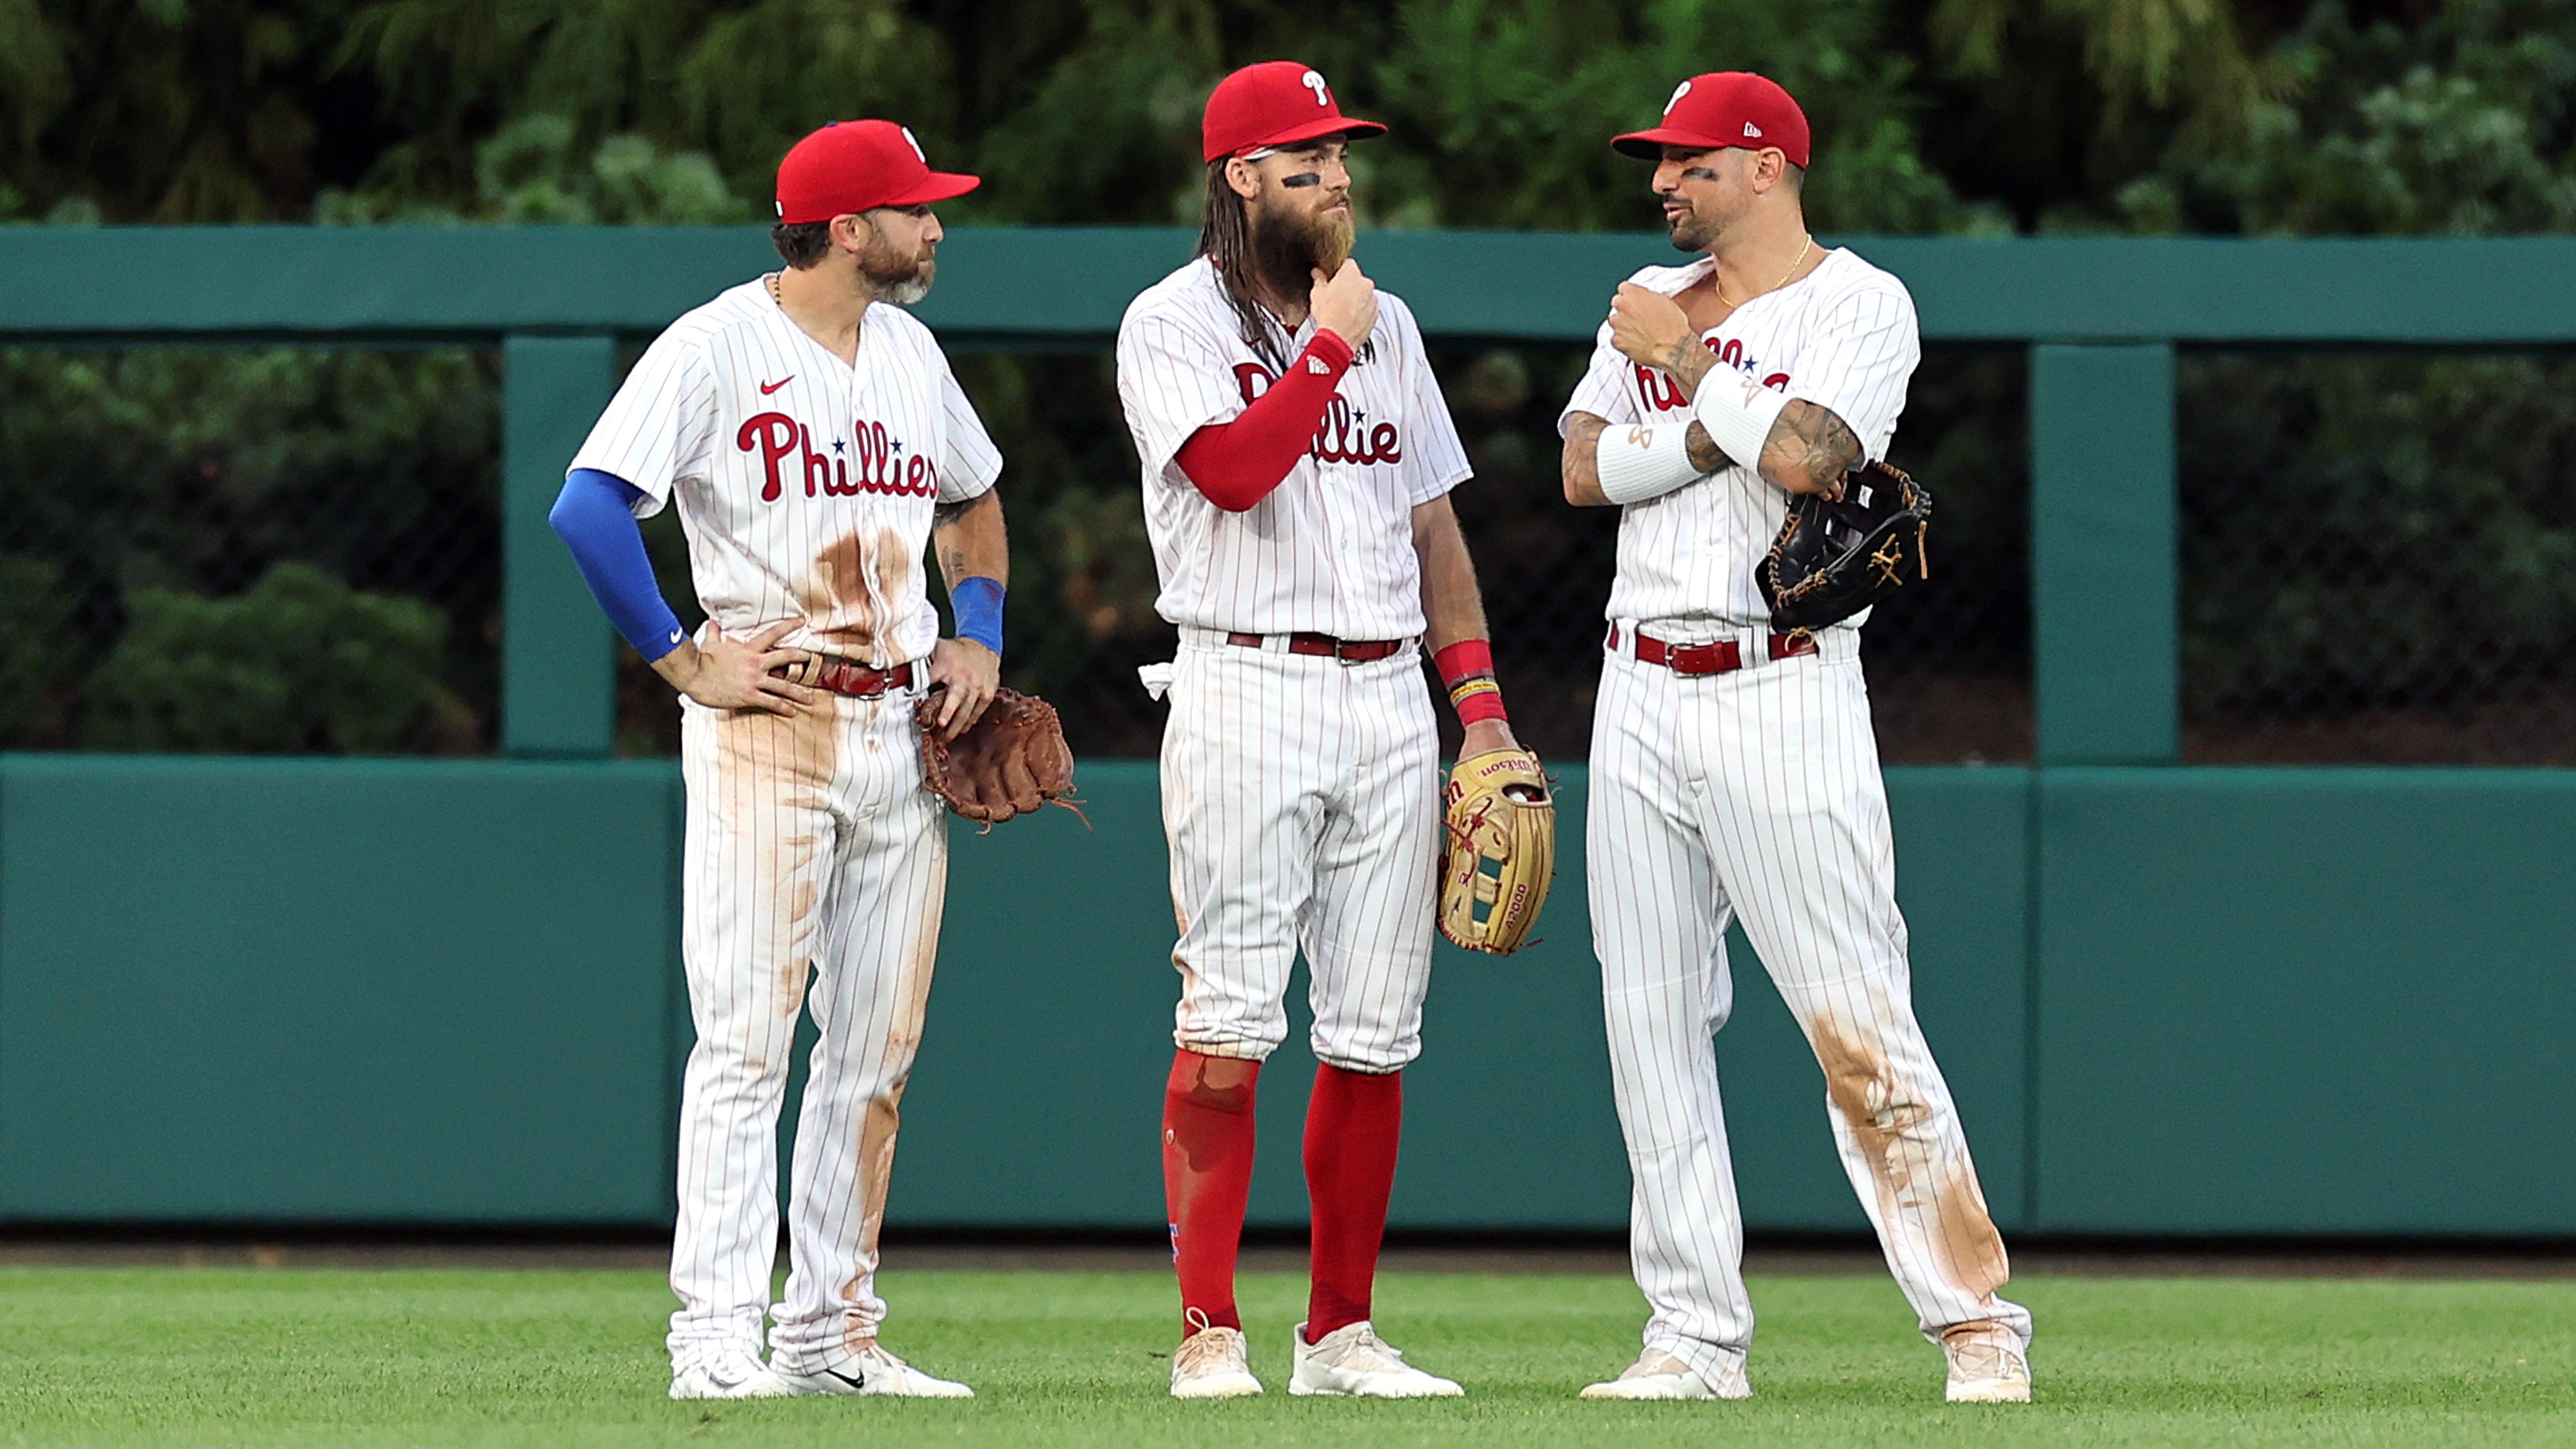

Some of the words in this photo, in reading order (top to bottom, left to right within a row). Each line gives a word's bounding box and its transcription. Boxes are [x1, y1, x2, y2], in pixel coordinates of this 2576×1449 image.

[737, 412, 938, 502] Phillies
[1480, 759, 1532, 777] Wilson
[1506, 884, 1527, 929] A2000
